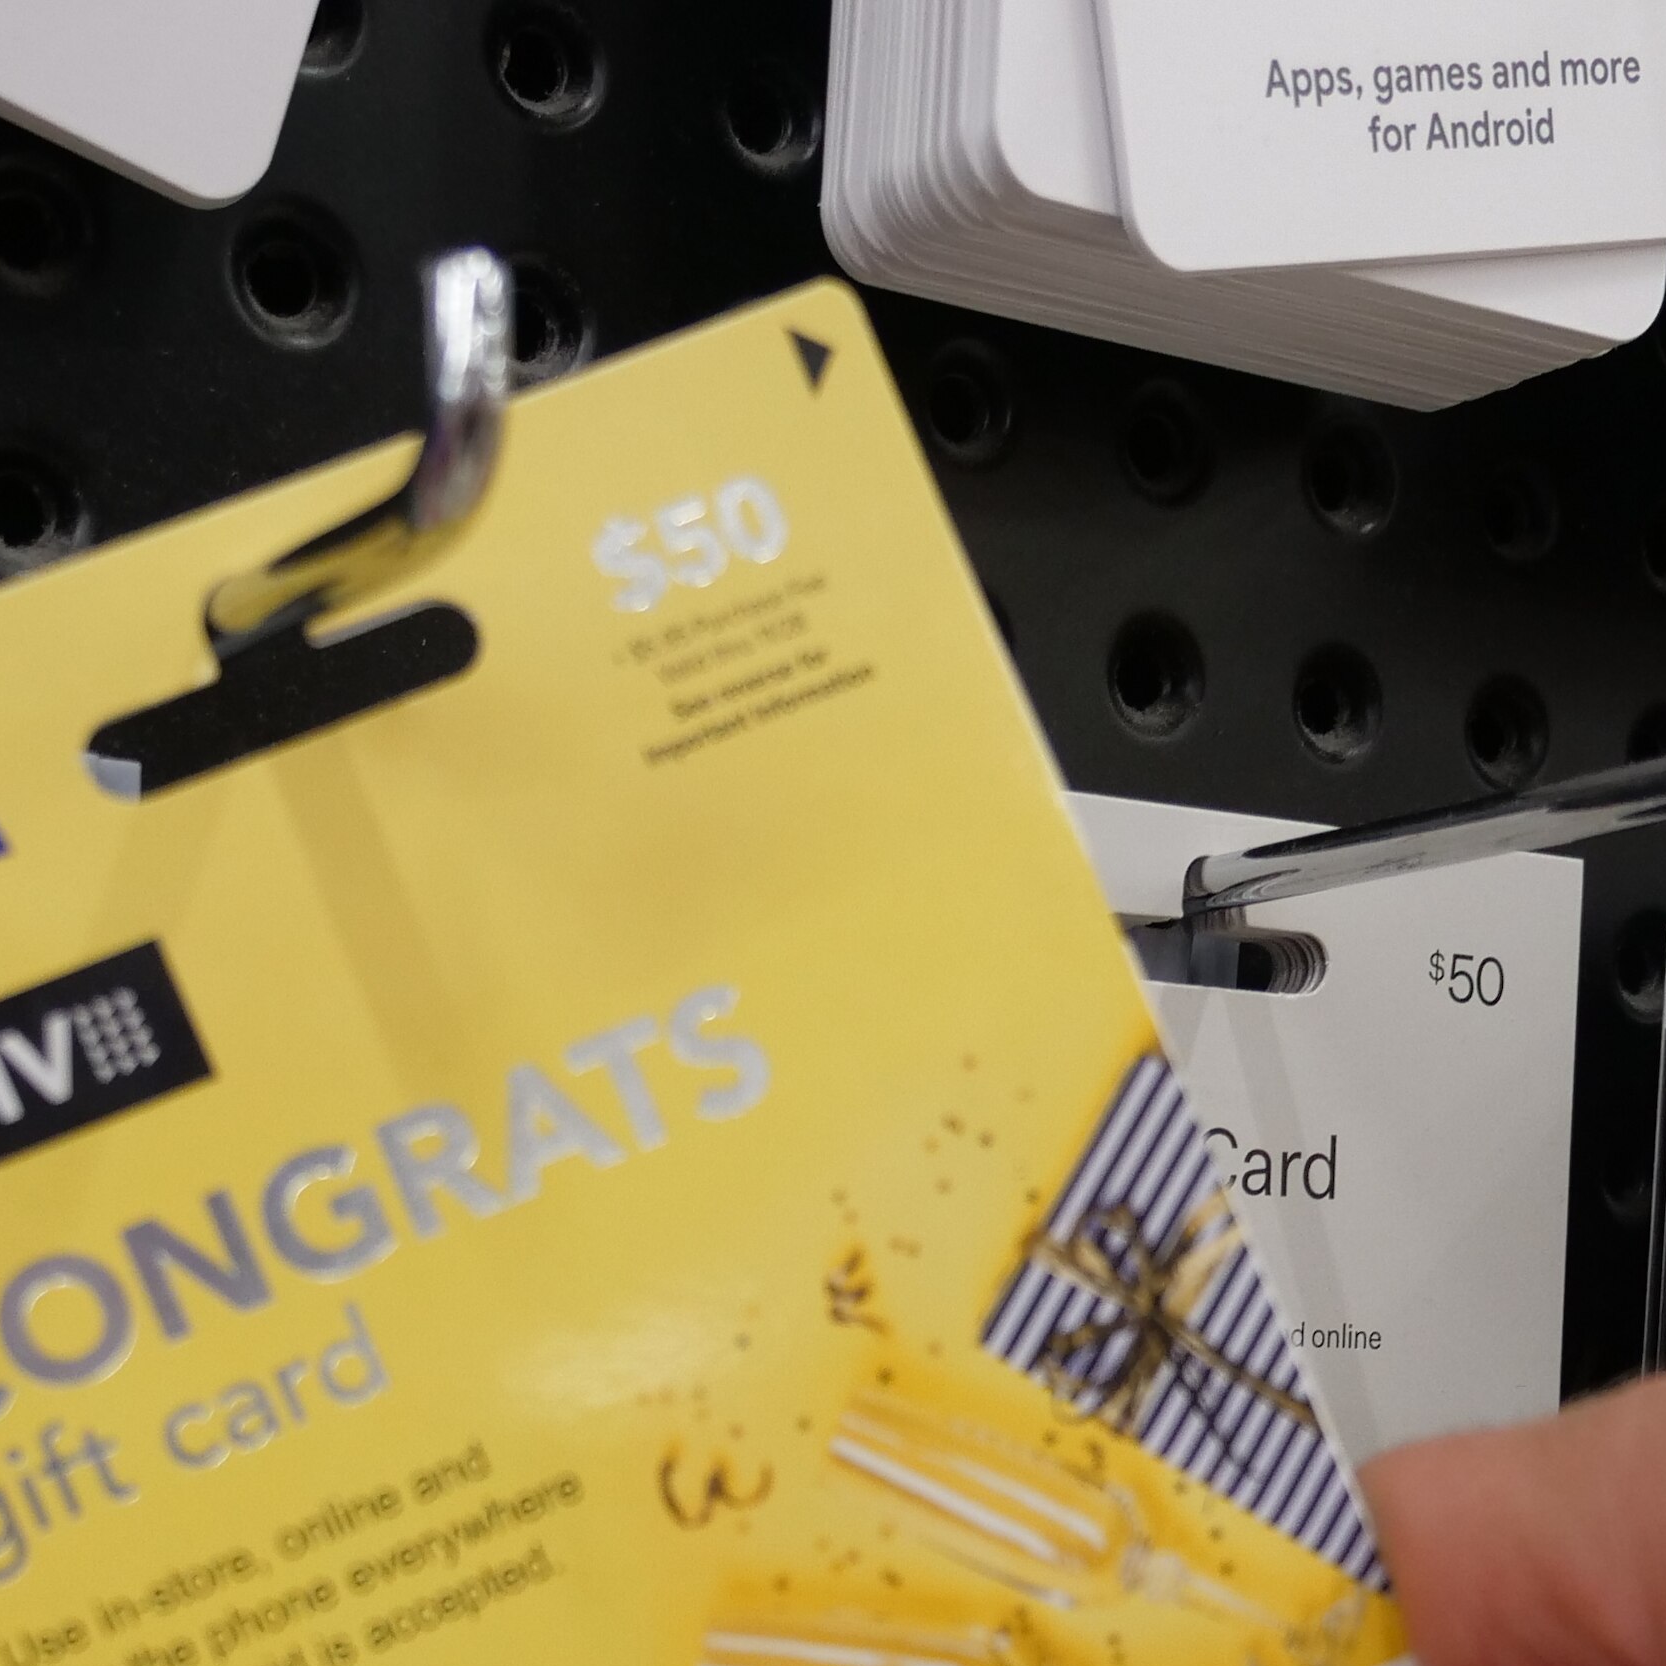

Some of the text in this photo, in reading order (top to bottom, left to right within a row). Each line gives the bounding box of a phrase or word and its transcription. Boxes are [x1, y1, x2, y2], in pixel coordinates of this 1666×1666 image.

[1265, 49, 1641, 108] Apps, games and more
[1368, 107, 1555, 153] for Android
[590, 472, 789, 614] $50
[1428, 949, 1505, 1007] $50
[1312, 1323, 1382, 1351] online
[163, 1302, 392, 1470] card
[98, 1546, 271, 1640] in-store,
[278, 1493, 404, 1565] online
[412, 1441, 493, 1511] and
[346, 1464, 586, 1600] everywhere
